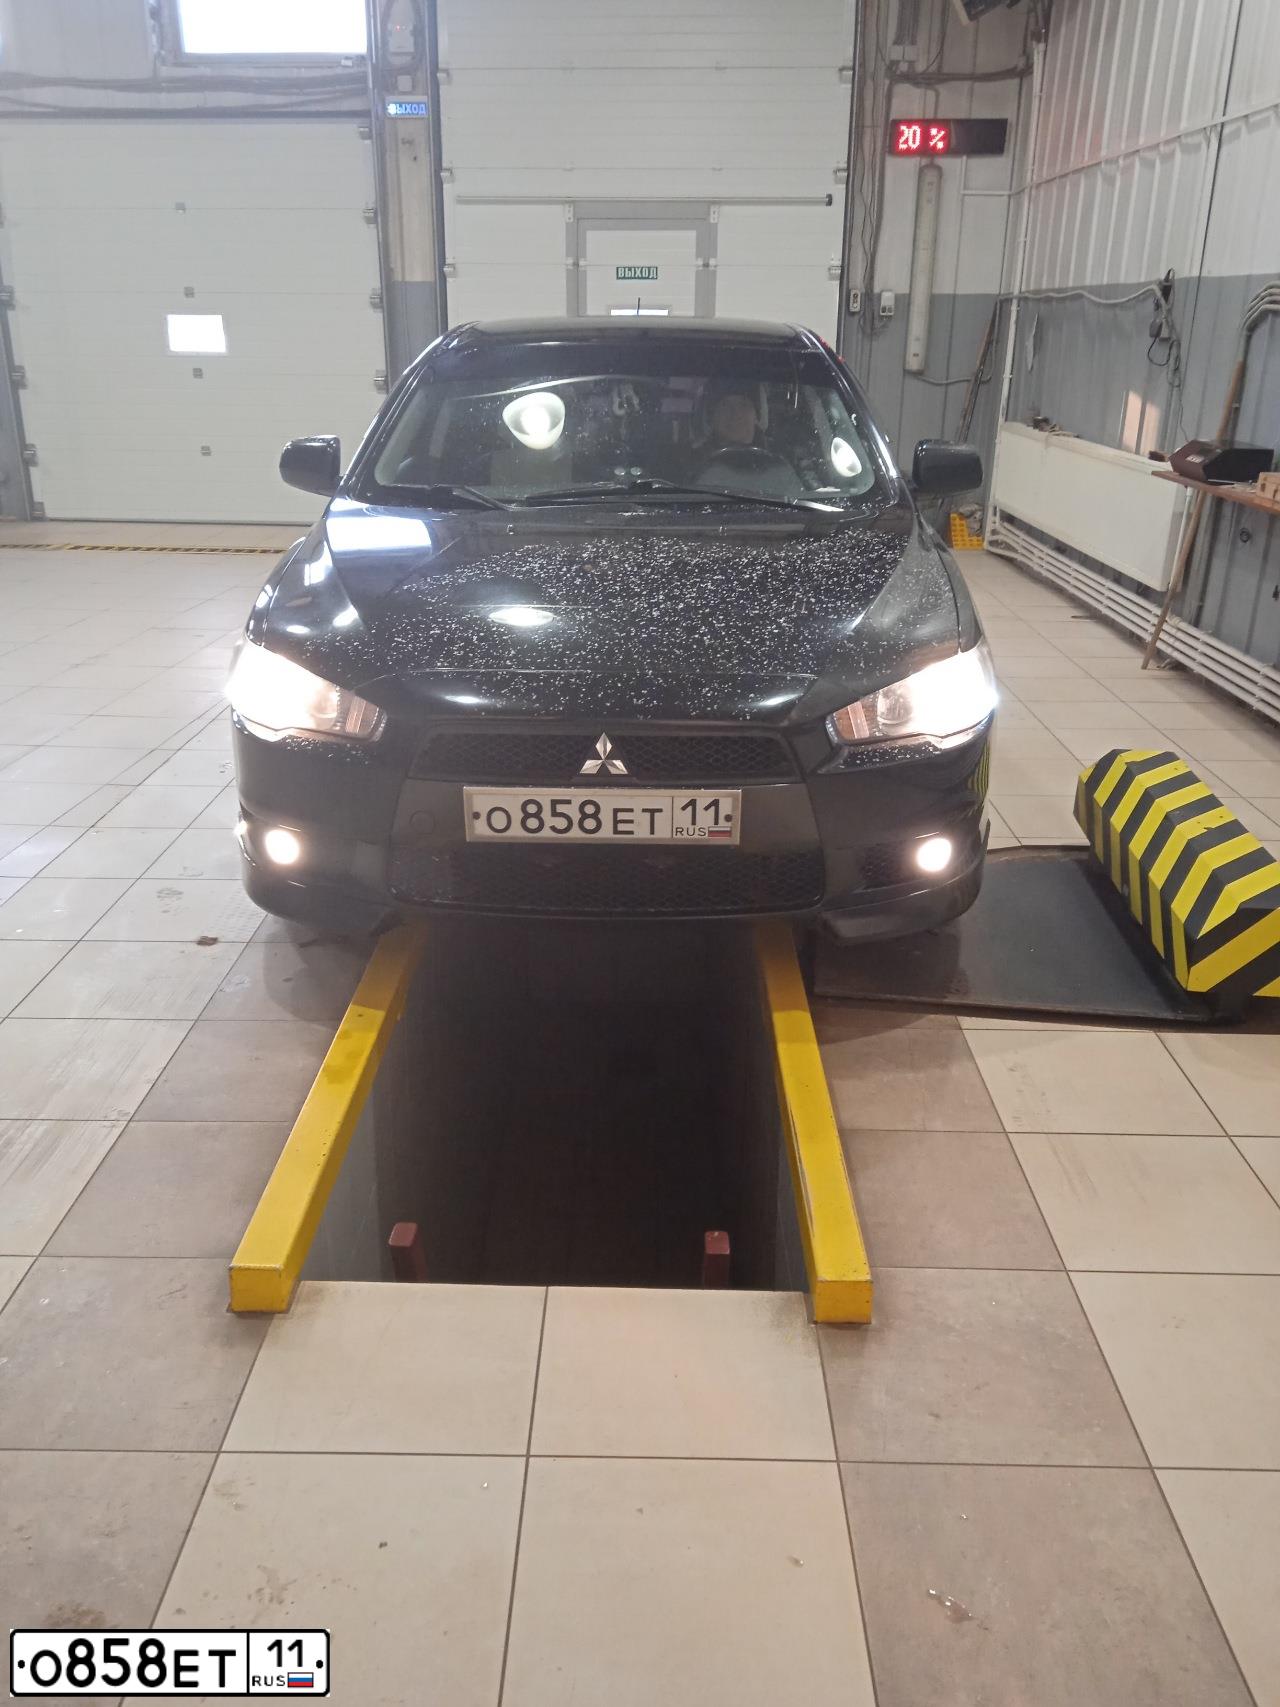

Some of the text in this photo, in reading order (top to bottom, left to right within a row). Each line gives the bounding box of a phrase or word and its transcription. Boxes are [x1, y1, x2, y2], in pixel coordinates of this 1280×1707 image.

[898, 125, 946, 150] 20 %
[618, 267, 657, 279] ВЫХОД
[680, 798, 720, 826] 11
[675, 826, 707, 837] RUS
